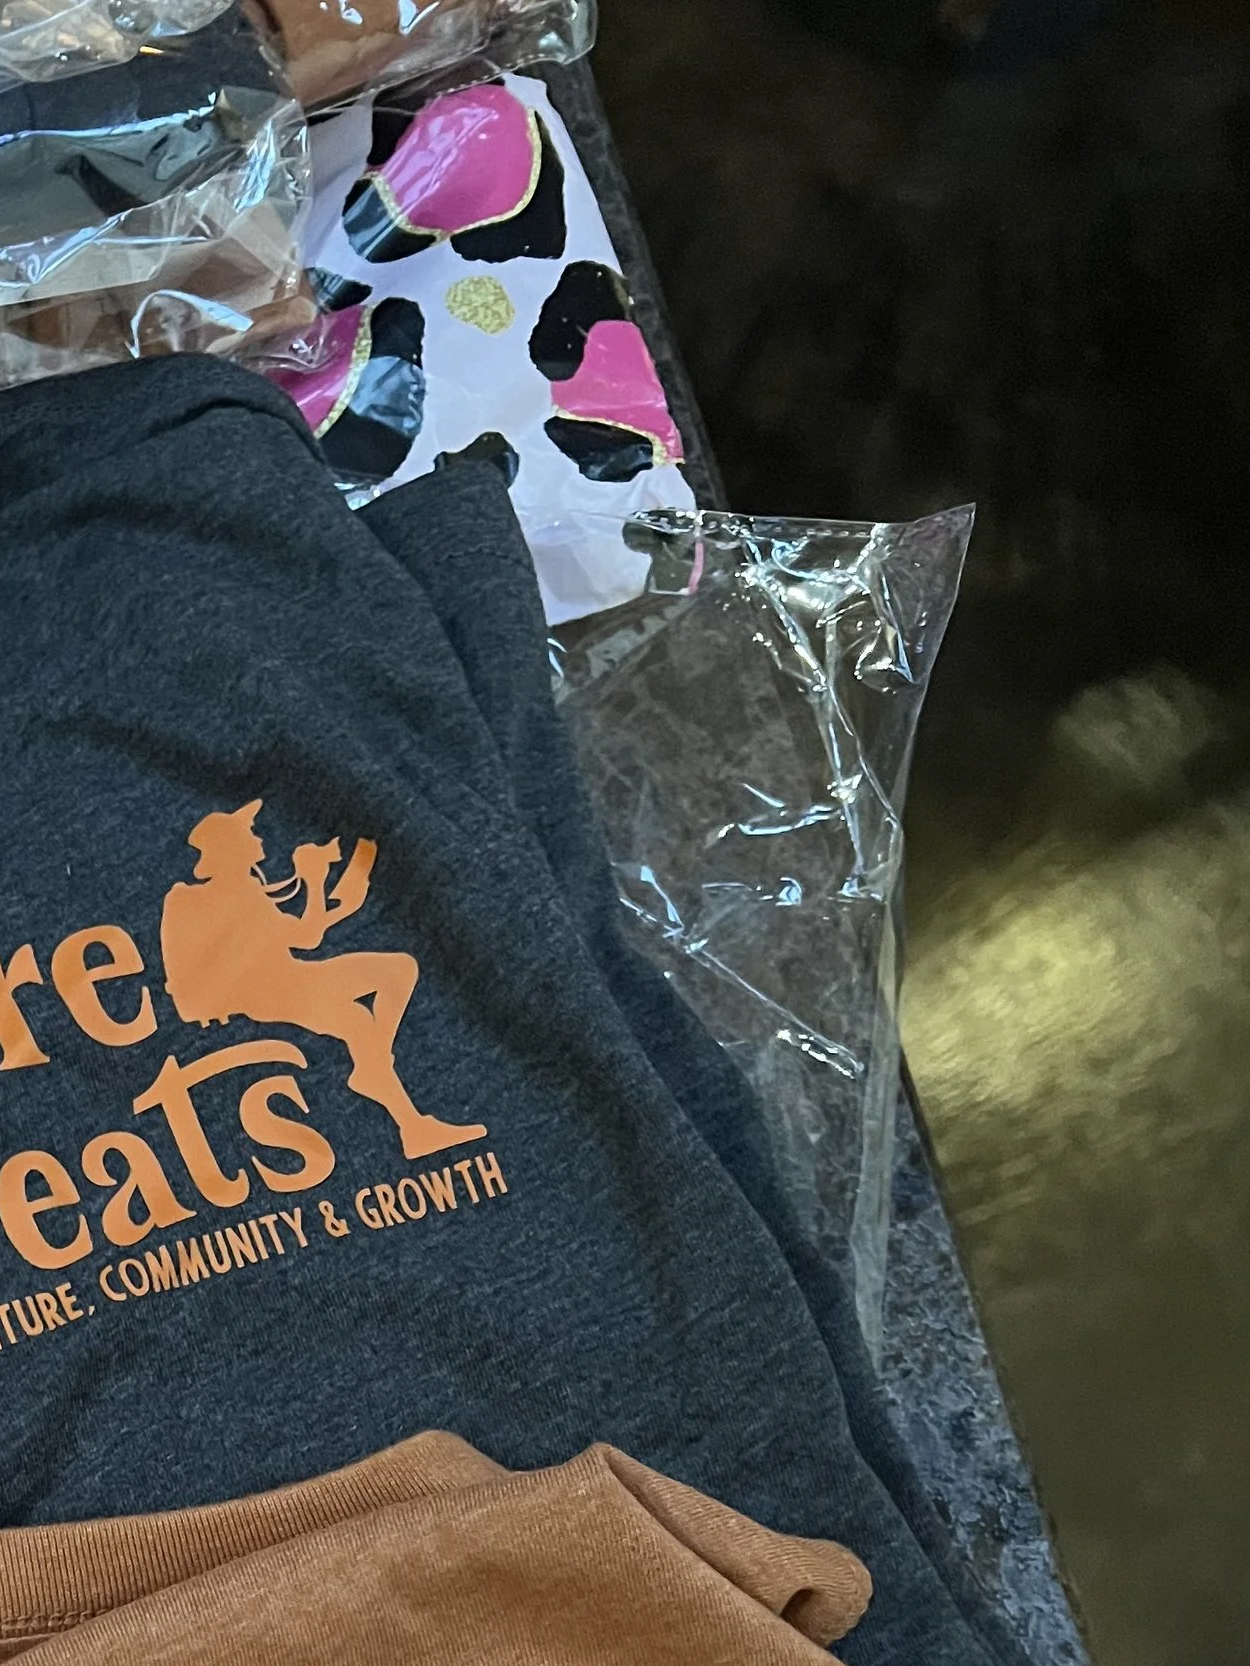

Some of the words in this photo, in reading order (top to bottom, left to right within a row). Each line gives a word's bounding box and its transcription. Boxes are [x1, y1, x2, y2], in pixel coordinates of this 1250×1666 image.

[99, 1207, 308, 1302] COMMUNITY
[324, 1200, 349, 1238] &
[355, 1152, 508, 1232] GROWTH
